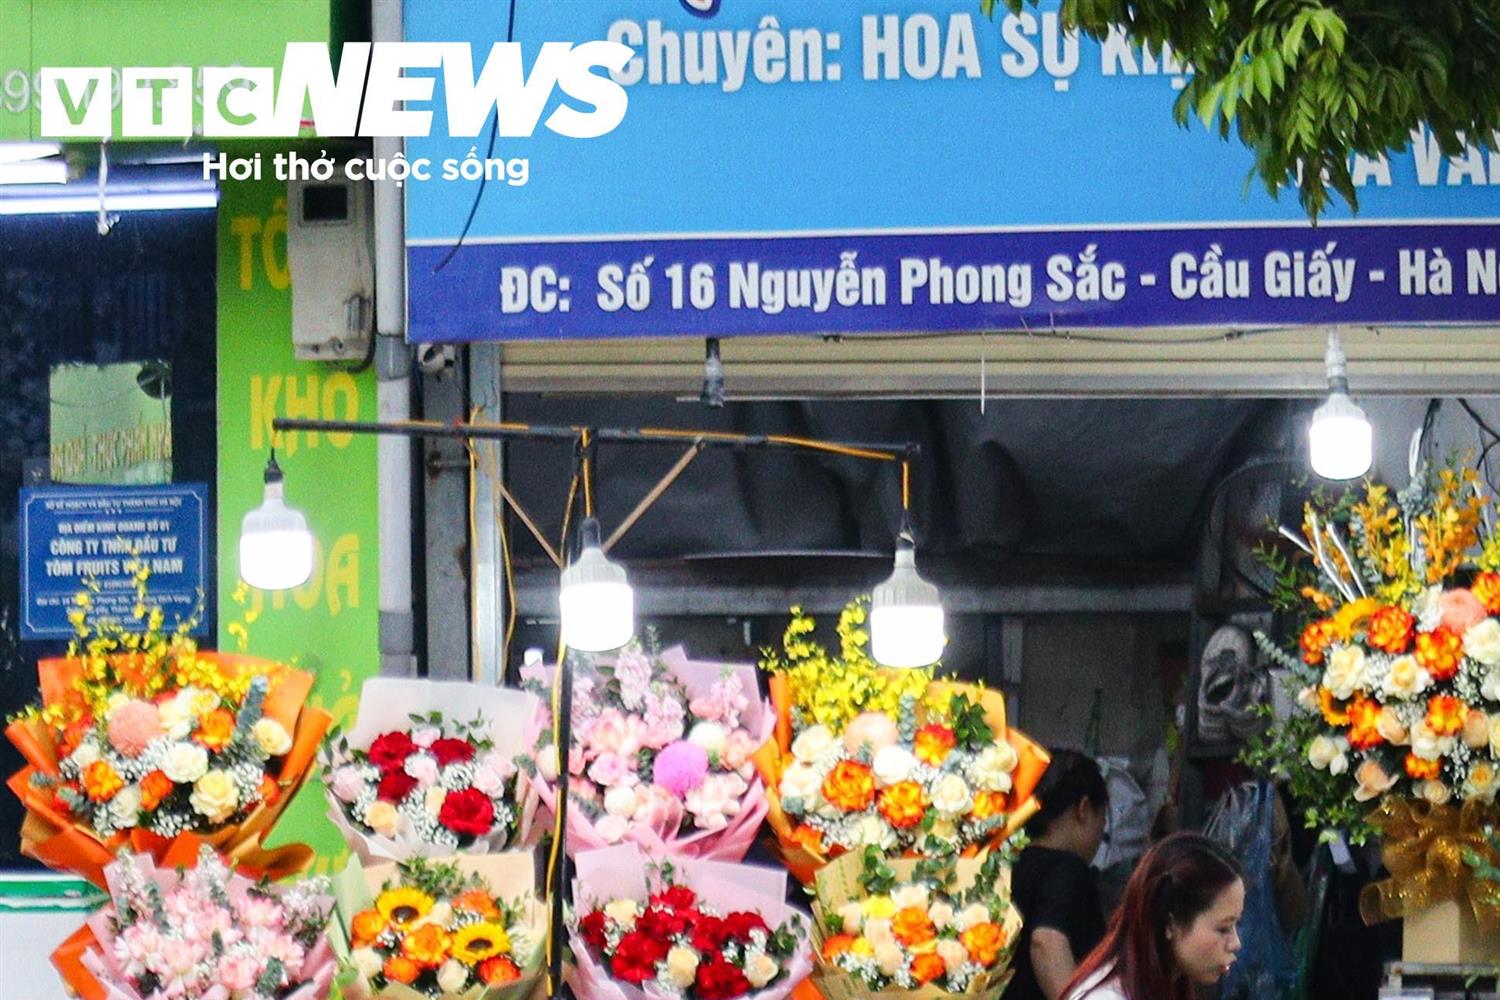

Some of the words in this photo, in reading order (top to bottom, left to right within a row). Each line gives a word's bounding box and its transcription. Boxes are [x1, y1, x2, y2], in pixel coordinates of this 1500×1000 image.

[606, 16, 841, 92] Chuyên:
[862, 15, 982, 82] HOA
[500, 266, 570, 314] ĐC:
[597, 253, 653, 312] Số
[665, 264, 715, 311] 16
[729, 251, 886, 314] Nguyễn
[903, 257, 1032, 308] Phong
[1045, 244, 1126, 302] Sắc
[1170, 243, 1250, 300] Cầu
[1264, 242, 1356, 303] Giấy
[1399, 247, 1452, 296] Hà
[250, 374, 359, 457] KHO
[85, 539, 99, 555] TY
[153, 557, 183, 575] NAM
